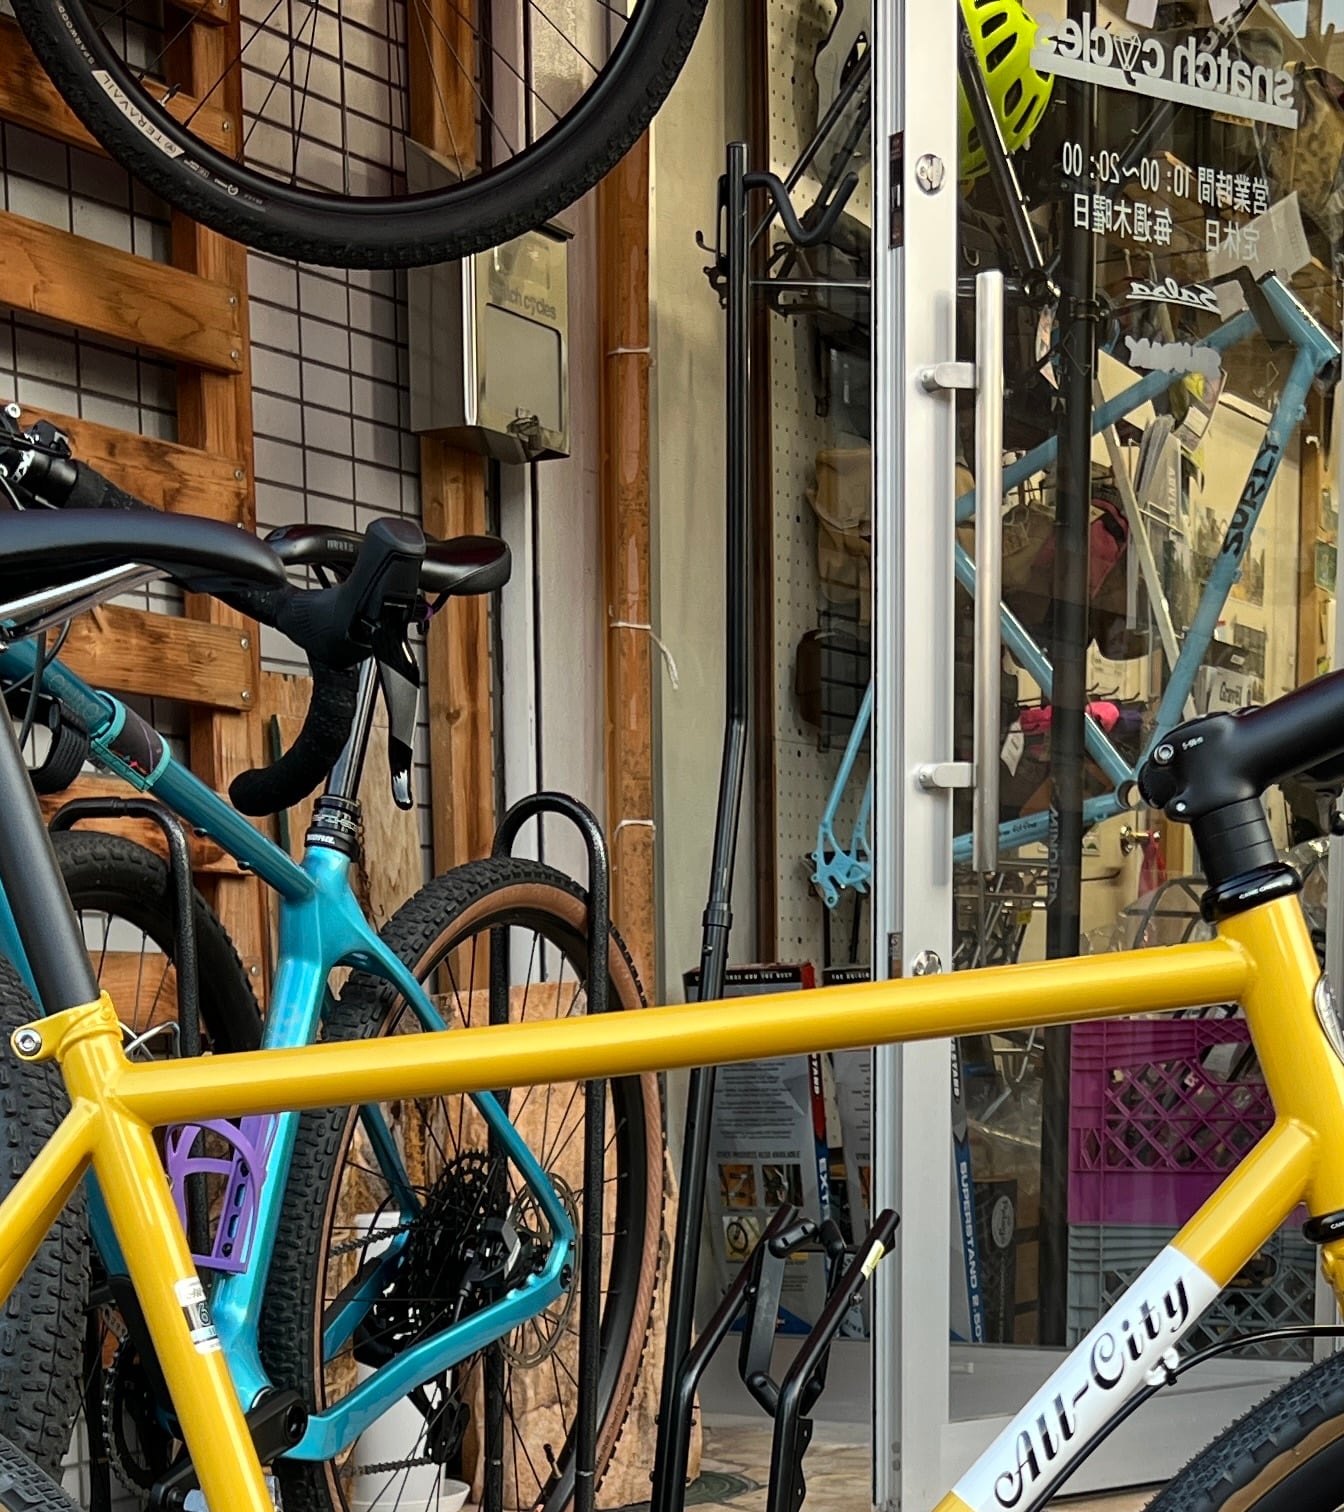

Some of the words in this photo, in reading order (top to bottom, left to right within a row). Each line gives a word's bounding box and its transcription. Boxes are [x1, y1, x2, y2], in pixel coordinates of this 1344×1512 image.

[103, 73, 164, 144] TERAVAIL
[1222, 434, 1280, 558] SURLY
[959, 1161, 979, 1289] SUPERSTAND
[993, 1275, 1191, 1510] All-City
